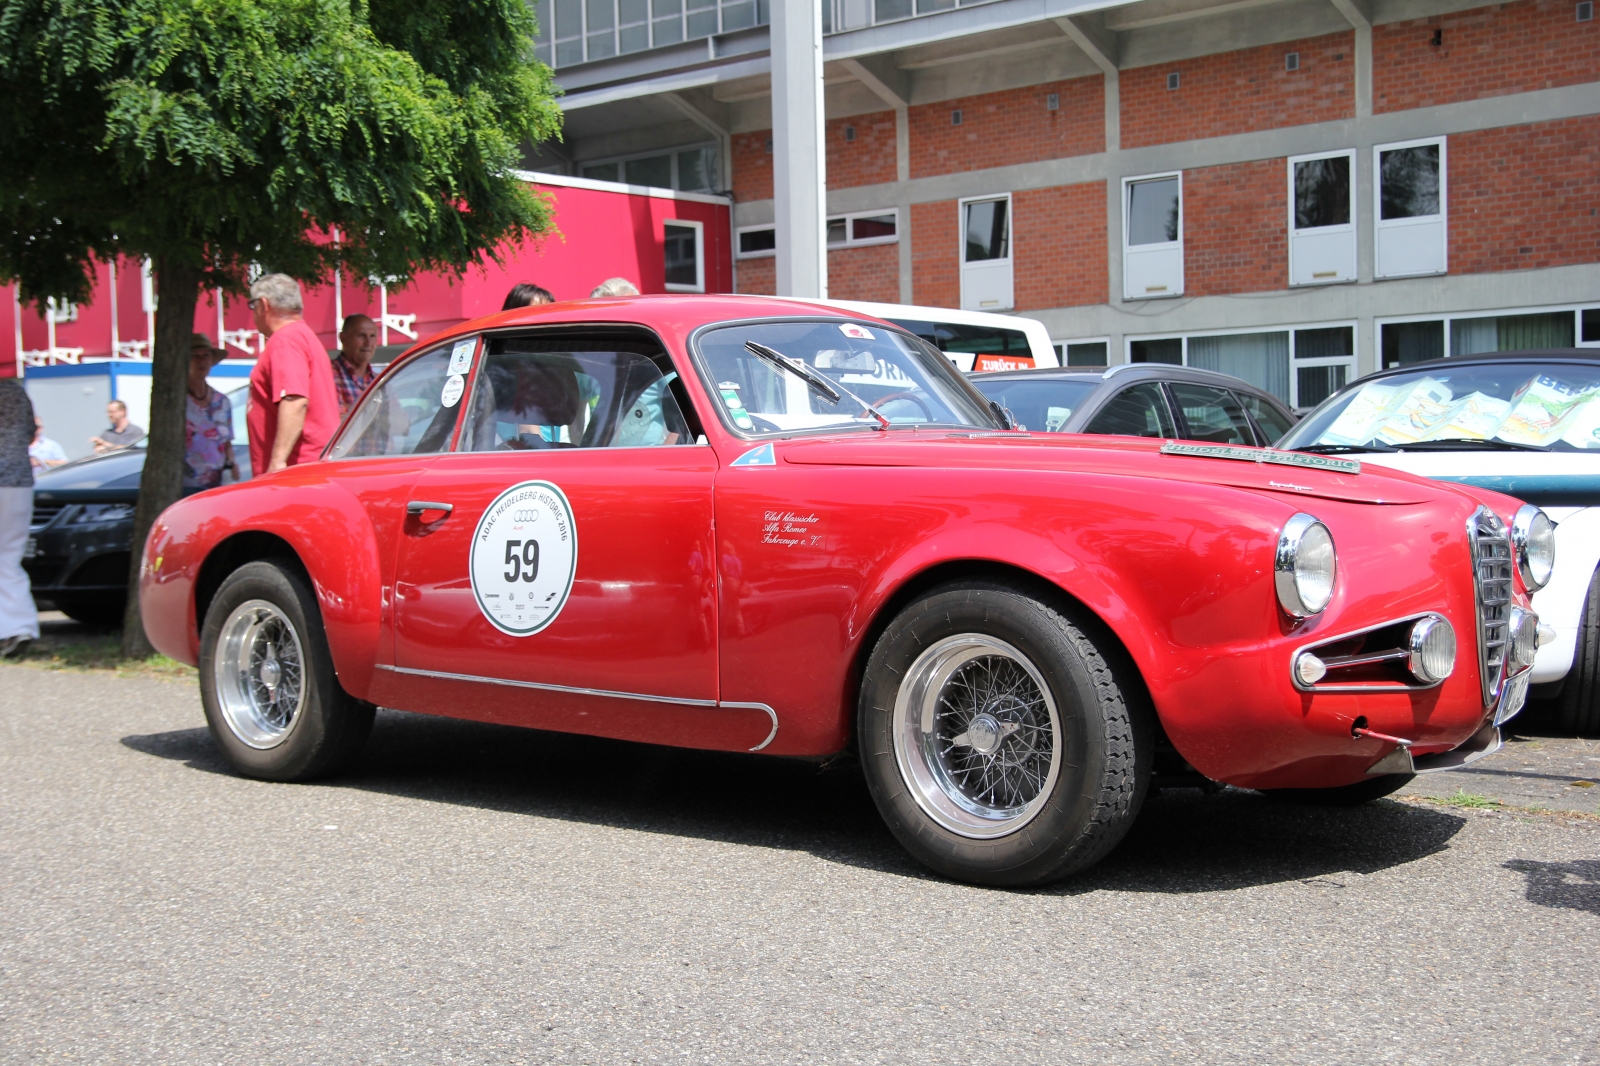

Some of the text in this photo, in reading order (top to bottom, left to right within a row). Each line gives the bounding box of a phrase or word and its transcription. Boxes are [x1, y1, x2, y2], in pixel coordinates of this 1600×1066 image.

[981, 358, 1016, 371] ZURÜCK
[481, 491, 568, 542] ADAC HEIDELBERG HISTORIC 2016
[764, 510, 820, 523] Club klassischer
[762, 522, 807, 535] Alfa Romeo
[761, 533, 799, 548] Fahrzeuge
[503, 539, 540, 583] 59
